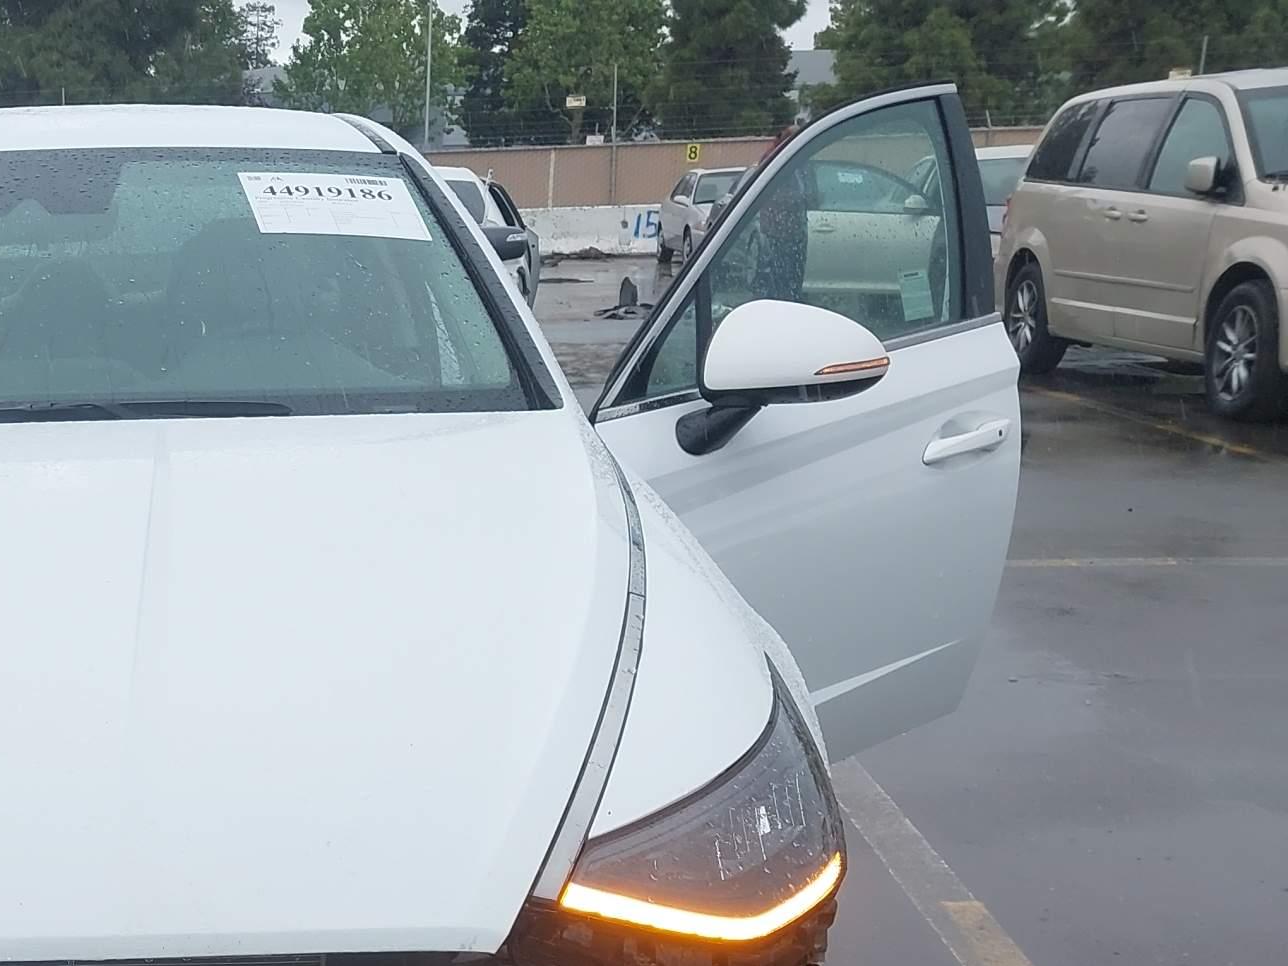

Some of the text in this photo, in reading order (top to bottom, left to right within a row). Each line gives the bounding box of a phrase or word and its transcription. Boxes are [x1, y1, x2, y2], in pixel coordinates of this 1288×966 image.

[689, 145, 698, 160] 8
[263, 184, 393, 201] 44919186
[634, 210, 660, 239] 15
